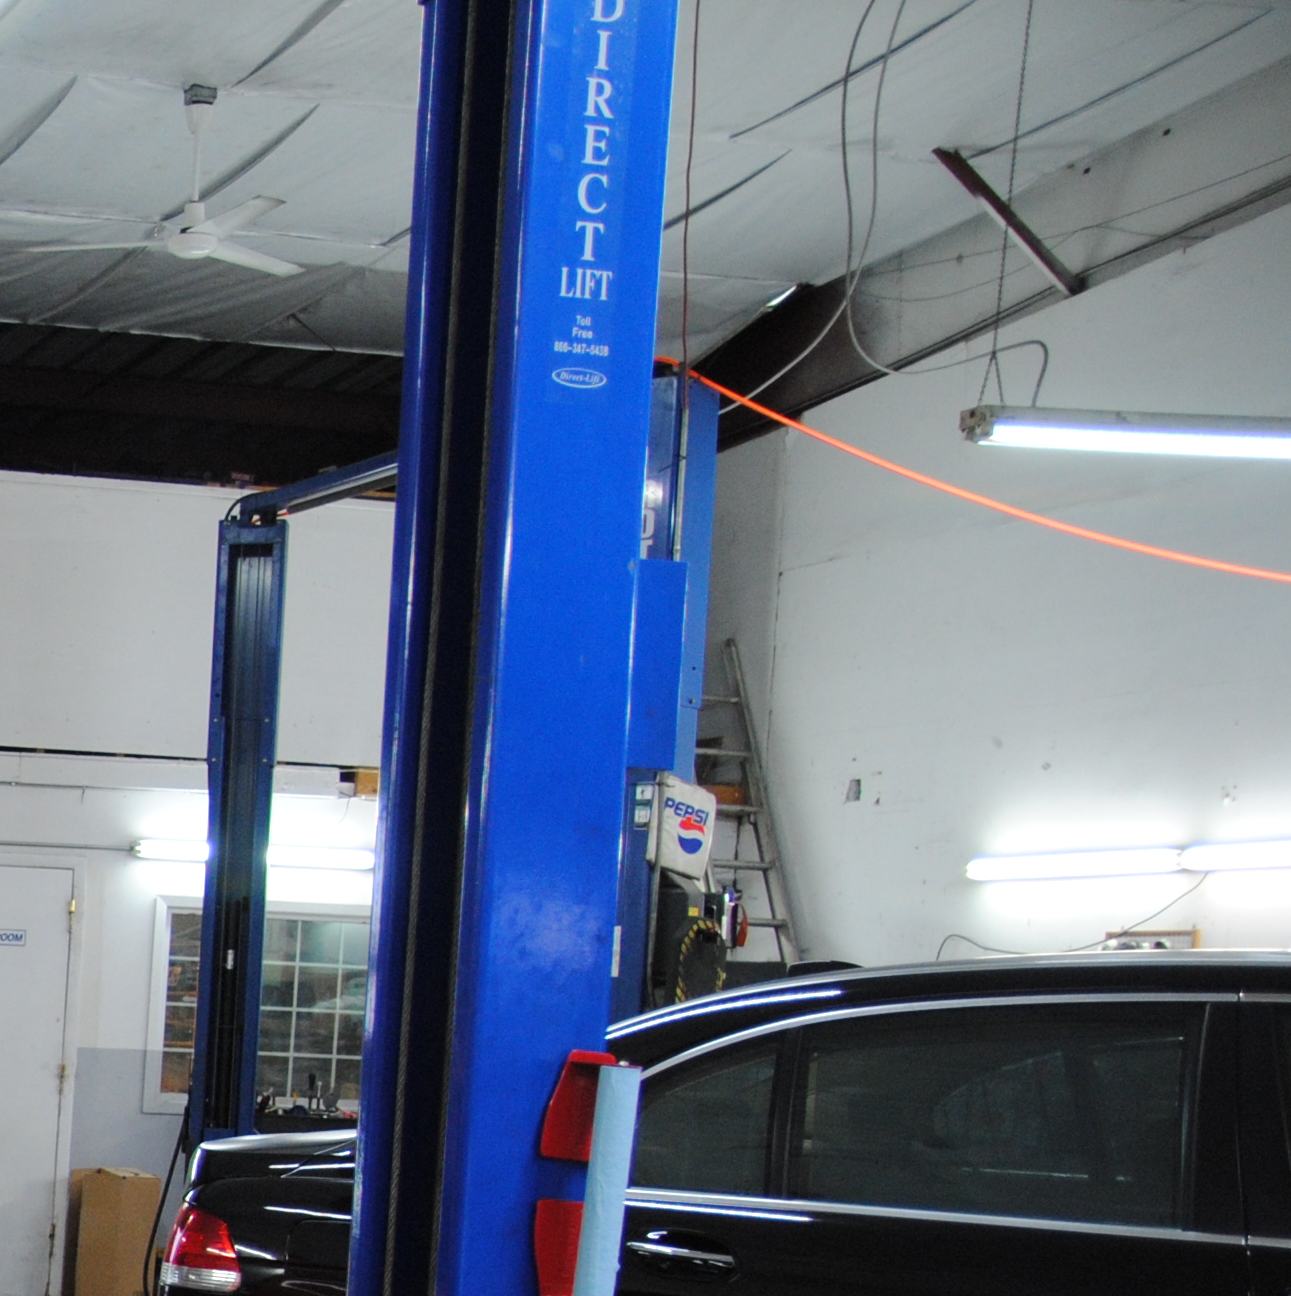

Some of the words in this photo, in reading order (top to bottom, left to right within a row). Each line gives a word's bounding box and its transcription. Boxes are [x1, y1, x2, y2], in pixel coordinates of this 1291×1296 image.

[559, 266, 613, 301] LIFT
[576, 314, 592, 326] Toll
[572, 327, 593, 339] Free
[664, 796, 709, 826] PEPSI
